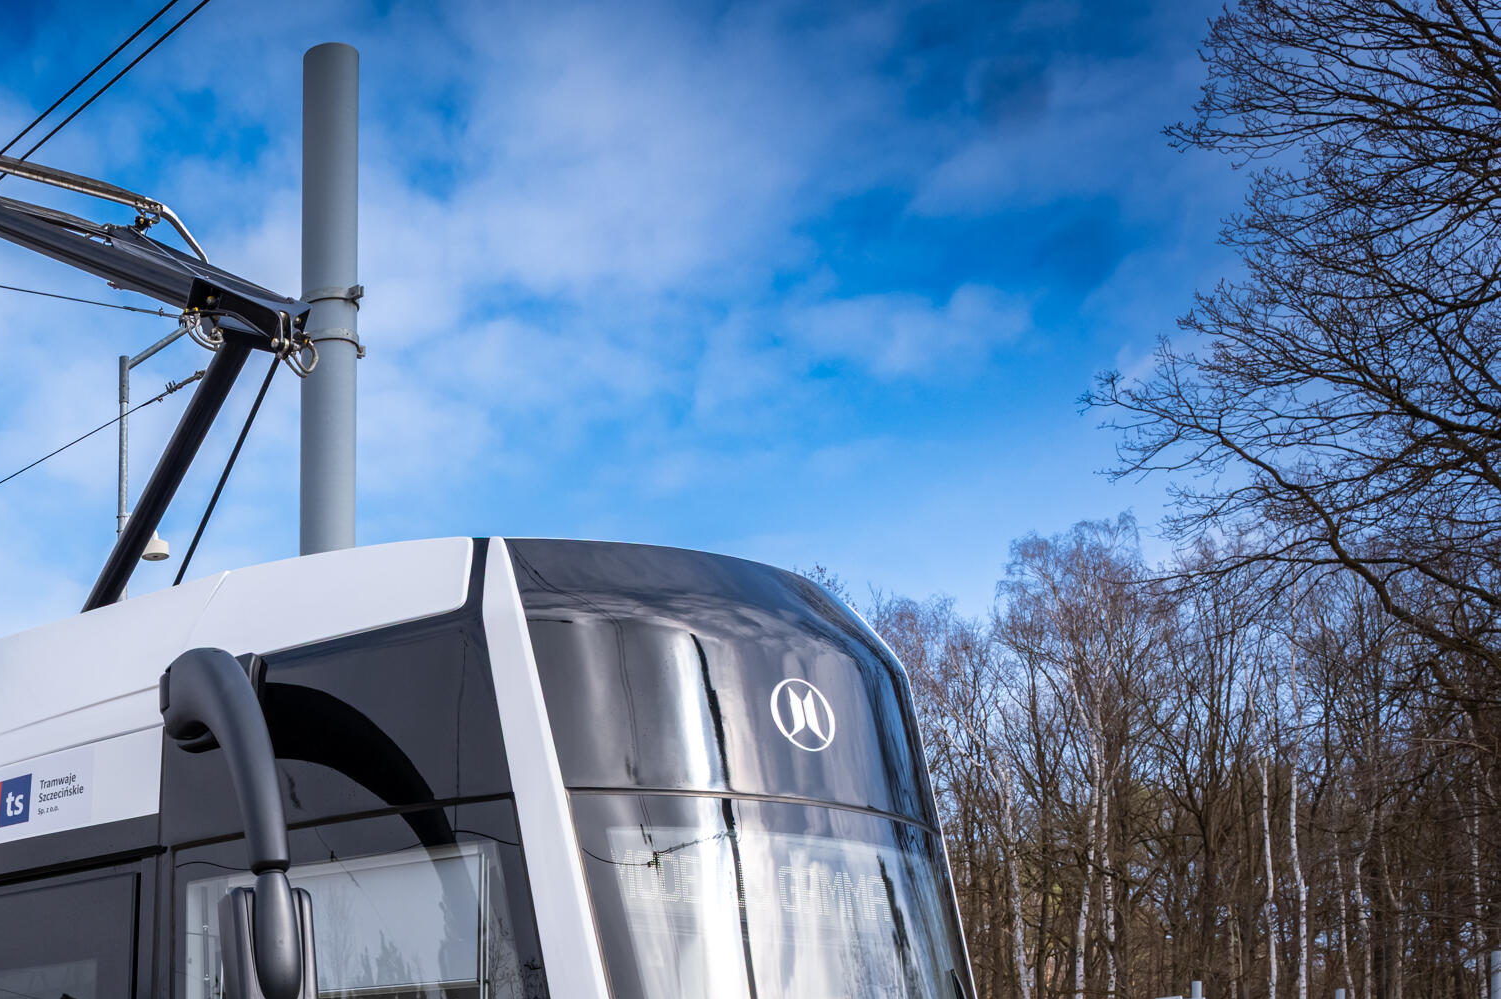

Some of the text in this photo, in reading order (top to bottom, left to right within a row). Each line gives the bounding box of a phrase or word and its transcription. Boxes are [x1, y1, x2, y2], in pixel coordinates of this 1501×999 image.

[40, 772, 77, 790] Tramwaje
[38, 784, 84, 803] Szczecińskie
[6, 791, 24, 817] ts
